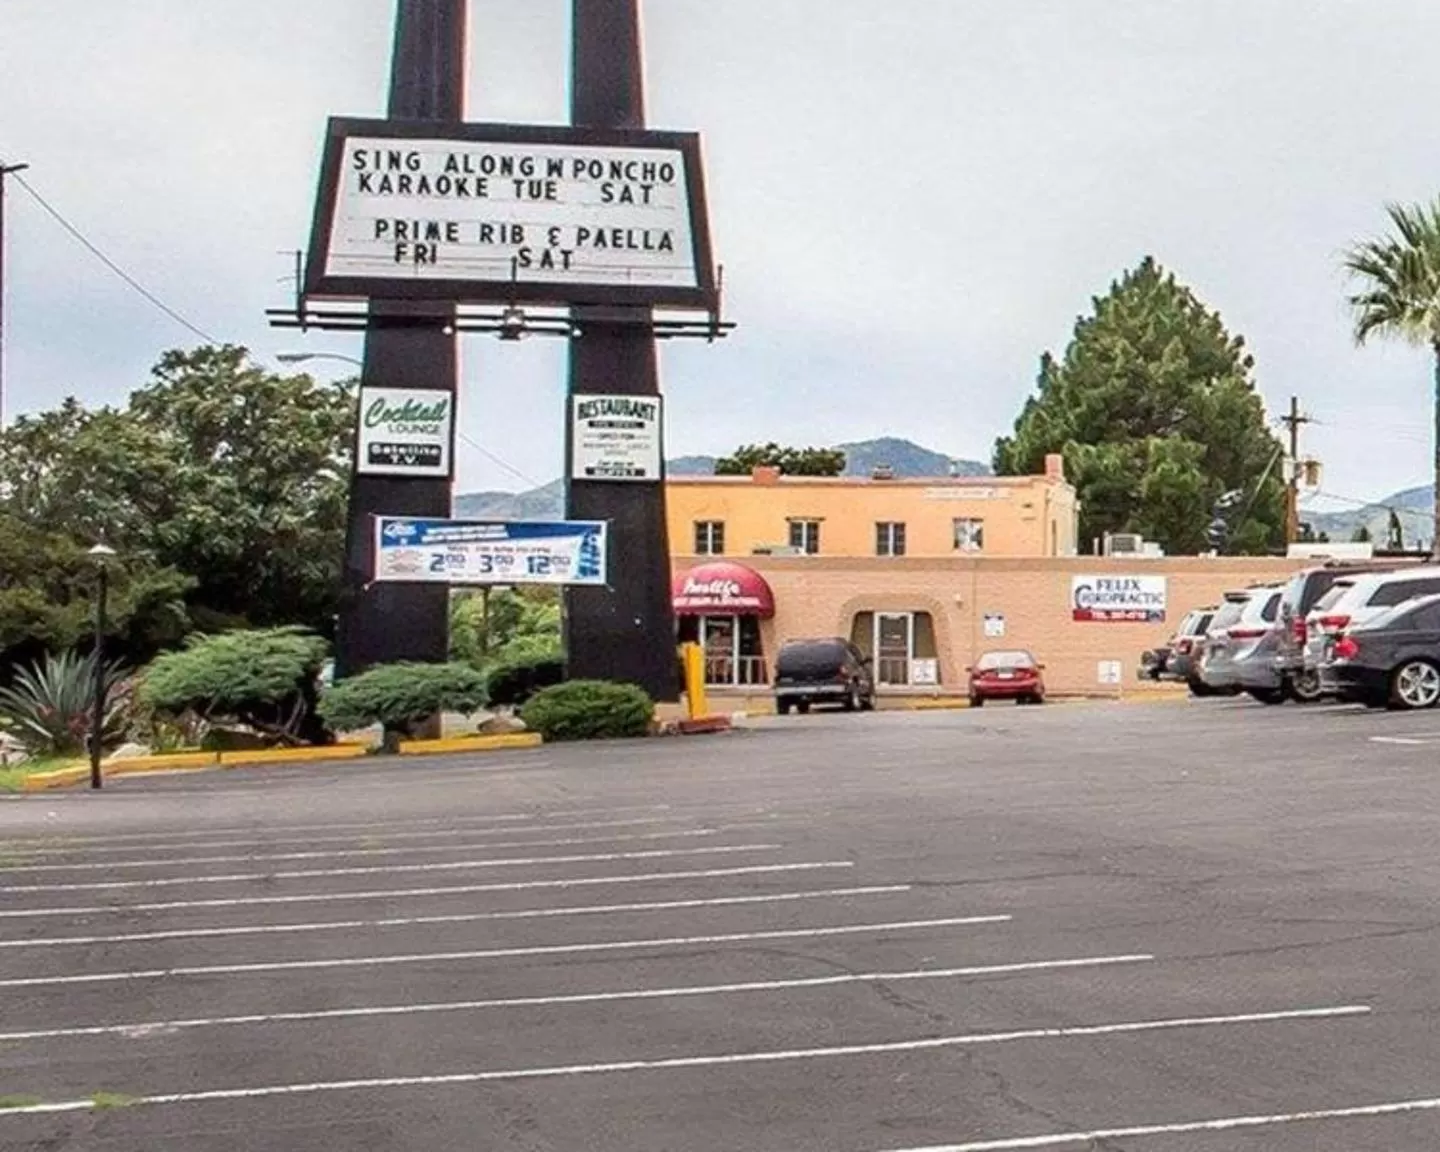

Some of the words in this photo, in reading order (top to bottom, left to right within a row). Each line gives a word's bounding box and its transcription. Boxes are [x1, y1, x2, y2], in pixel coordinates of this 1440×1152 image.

[353, 149, 420, 172] SING
[445, 153, 534, 176] ALONG
[547, 158, 565, 177] W
[573, 159, 676, 183] PONCHO
[358, 175, 489, 198] KARAOKE
[513, 179, 558, 200] TUE
[601, 182, 653, 204] SAT
[374, 219, 459, 243] PRIME
[480, 223, 525, 245] RIB
[576, 228, 673, 251] PAELLA
[394, 242, 438, 264] FRI
[518, 248, 574, 270] SAT
[364, 397, 449, 428] Cocktail
[578, 399, 656, 422] RESTAURANT
[387, 423, 441, 435] LOUNGE
[1096, 578, 1141, 591] FELIX
